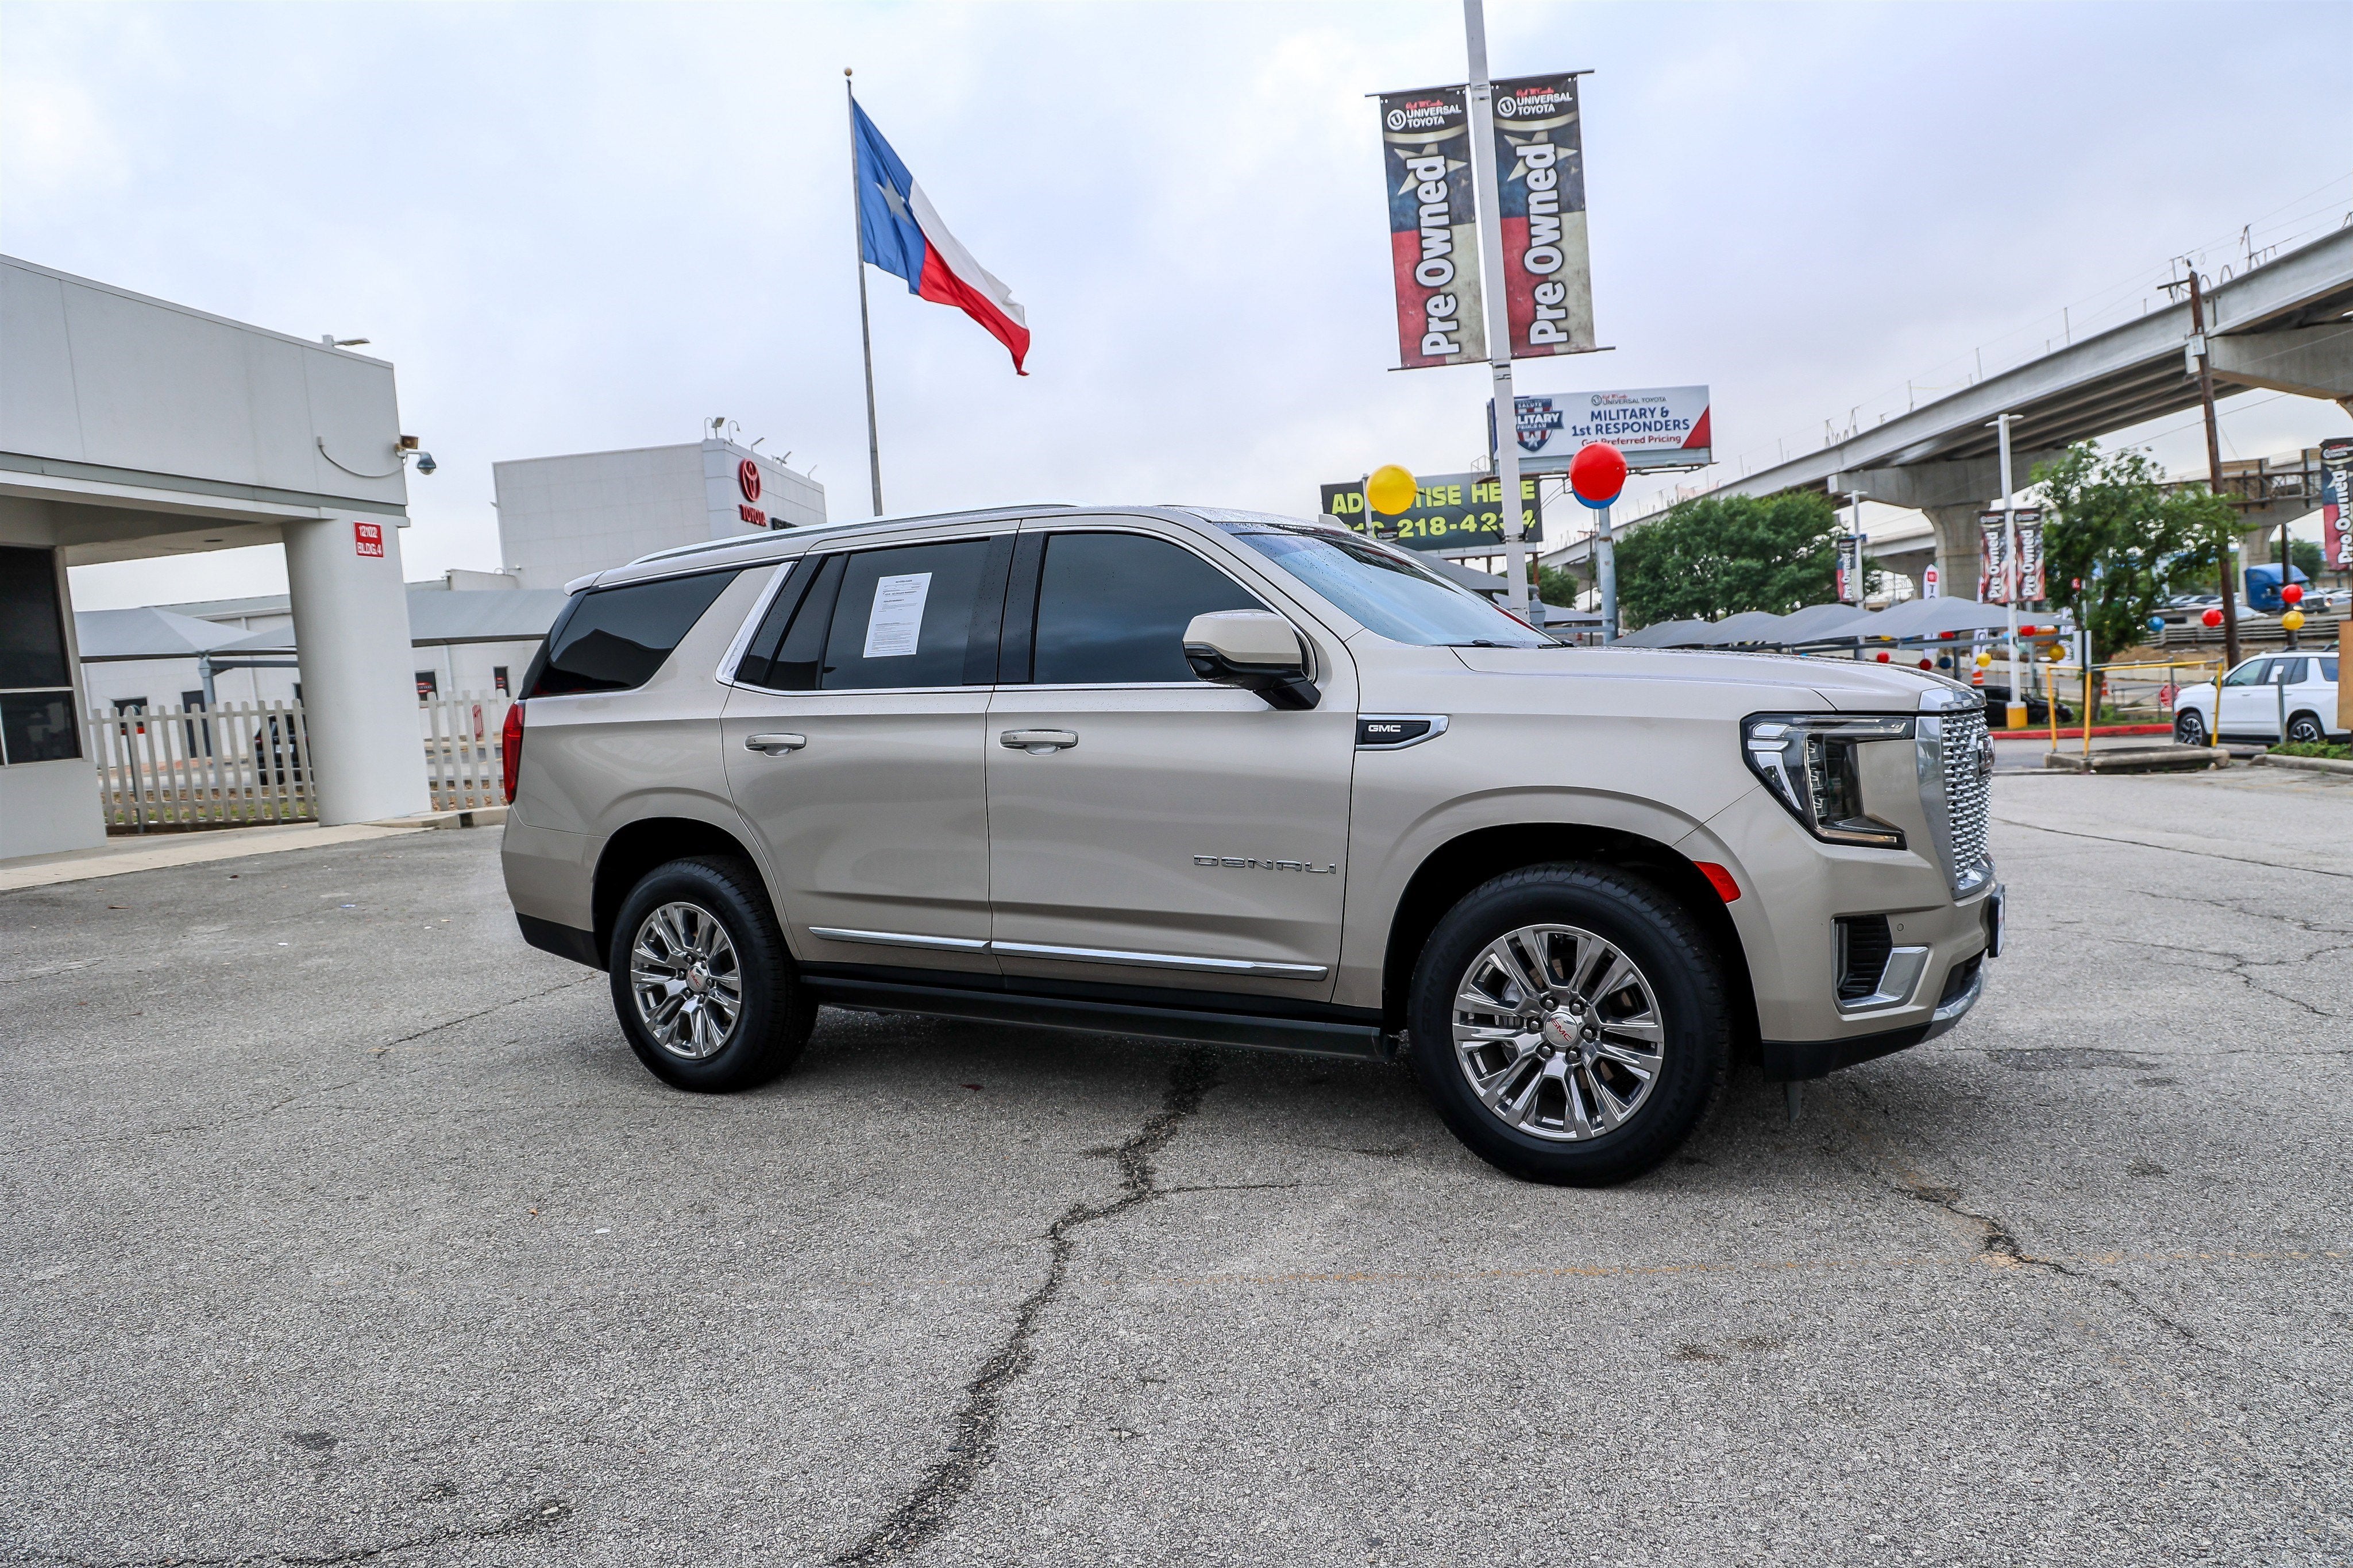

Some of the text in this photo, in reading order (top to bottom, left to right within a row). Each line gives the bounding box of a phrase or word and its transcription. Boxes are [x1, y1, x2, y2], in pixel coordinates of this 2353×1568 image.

[1516, 91, 1573, 106] UNIVERSAL
[1406, 104, 1463, 119] UNIVERSAL
[1517, 103, 1556, 116] TOYOTA
[1407, 115, 1445, 129] TOYOTA
[1516, 143, 1568, 345] Pre Owned
[1406, 155, 1460, 356] Pre Owned
[1603, 397, 1640, 405] UNIVERSAL
[1517, 412, 1560, 424] LITARY
[1591, 406, 1669, 422] MILITARY &
[1572, 419, 1690, 437] 1st RESPONDERS
[1601, 435, 1645, 445] Preferred
[1648, 434, 1681, 444] Pricing
[1471, 480, 1536, 504] HEE
[741, 504, 767, 527] TOYOTA
[358, 525, 378, 538] 12102
[357, 542, 383, 555] BLDG 4
[1984, 531, 2000, 575] Owned
[2019, 529, 2036, 574] Owned
[1368, 724, 1401, 732] GMC
[1193, 854, 1337, 875] DENALI
[1551, 1017, 1572, 1042] GMC
